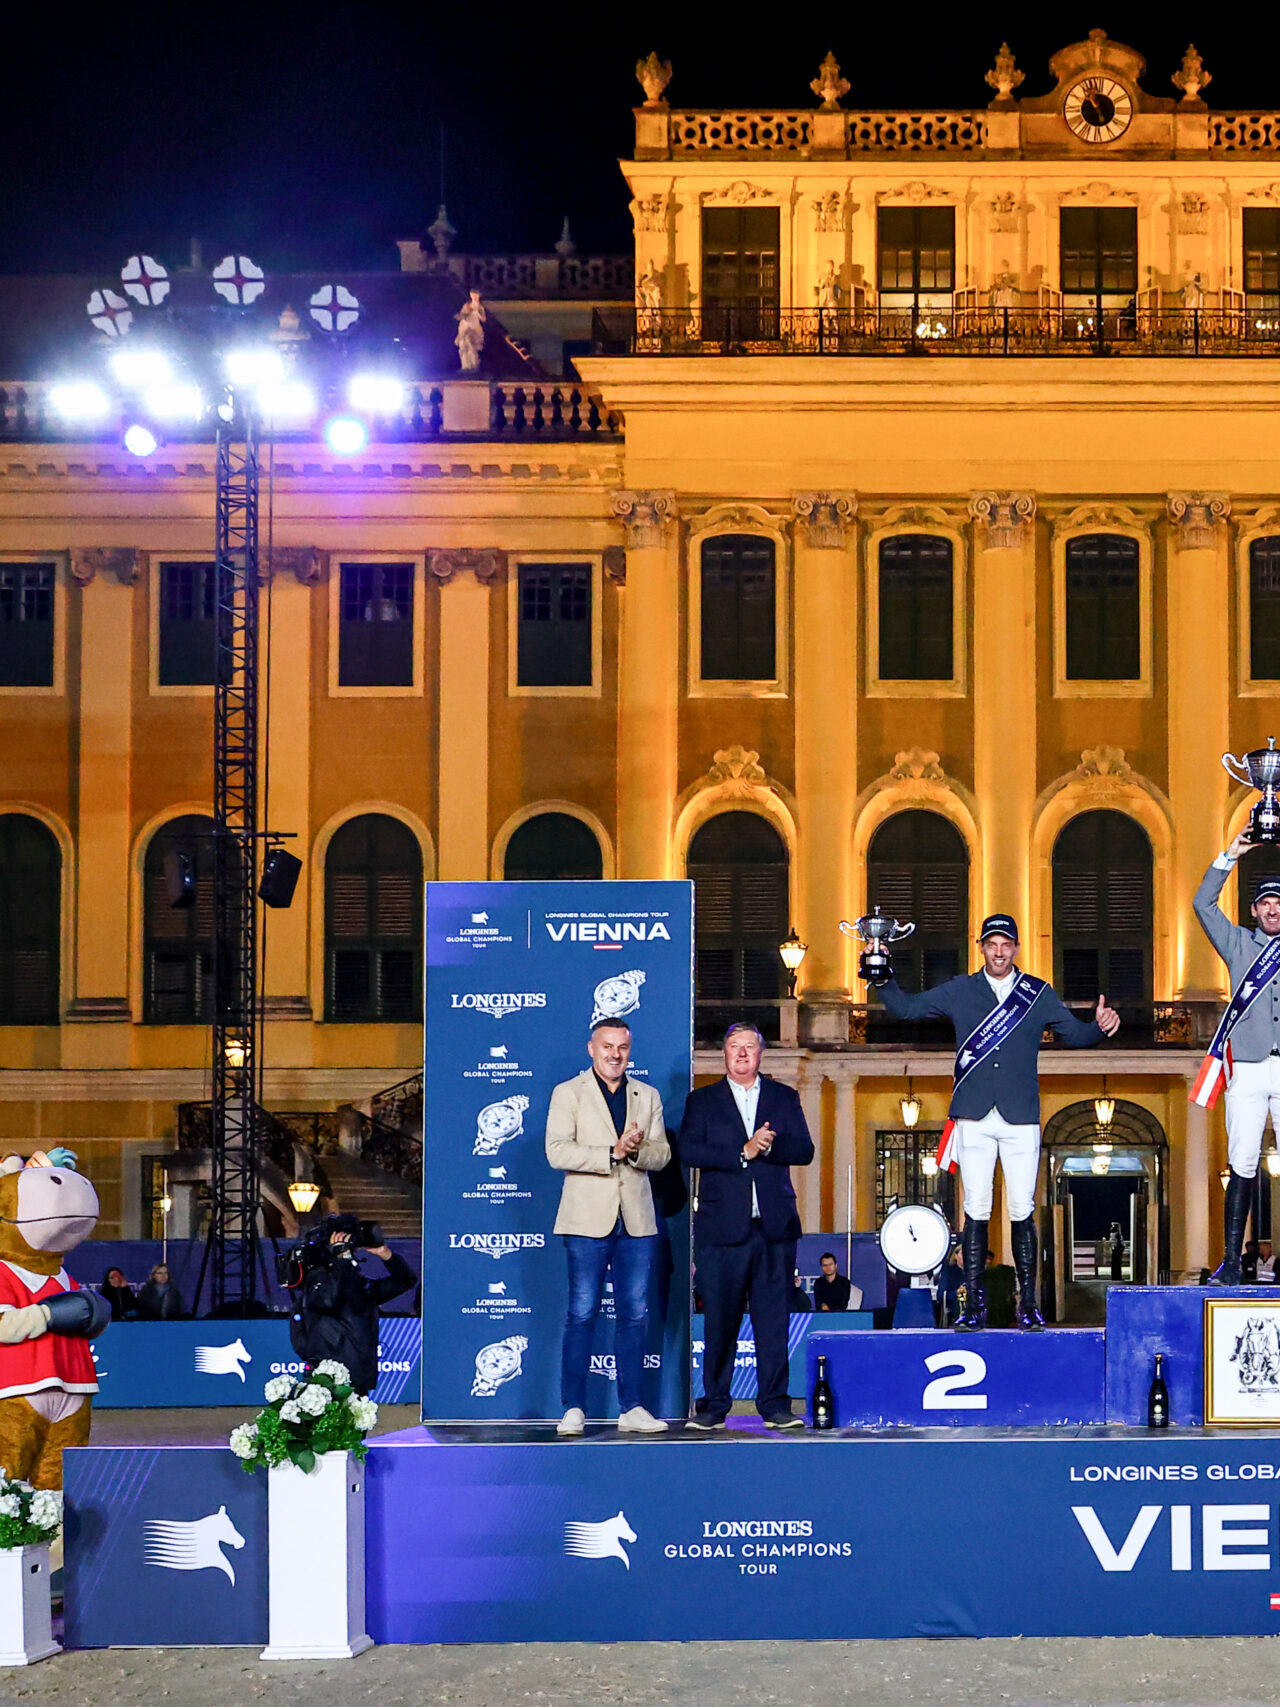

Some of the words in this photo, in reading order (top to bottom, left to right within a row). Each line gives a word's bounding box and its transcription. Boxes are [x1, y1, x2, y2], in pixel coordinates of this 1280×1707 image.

[545, 922, 671, 941] VIENNA
[450, 993, 546, 1008] LONGINES
[449, 1233, 546, 1248] LONGINES
[922, 1349, 988, 1410] 2
[1069, 1464, 1199, 1482] LONGINES
[702, 1520, 813, 1538] LONGINES
[664, 1544, 735, 1558] GLOBAL
[741, 1543, 852, 1558] CHAMPIONS
[739, 1564, 778, 1575] TOUR
